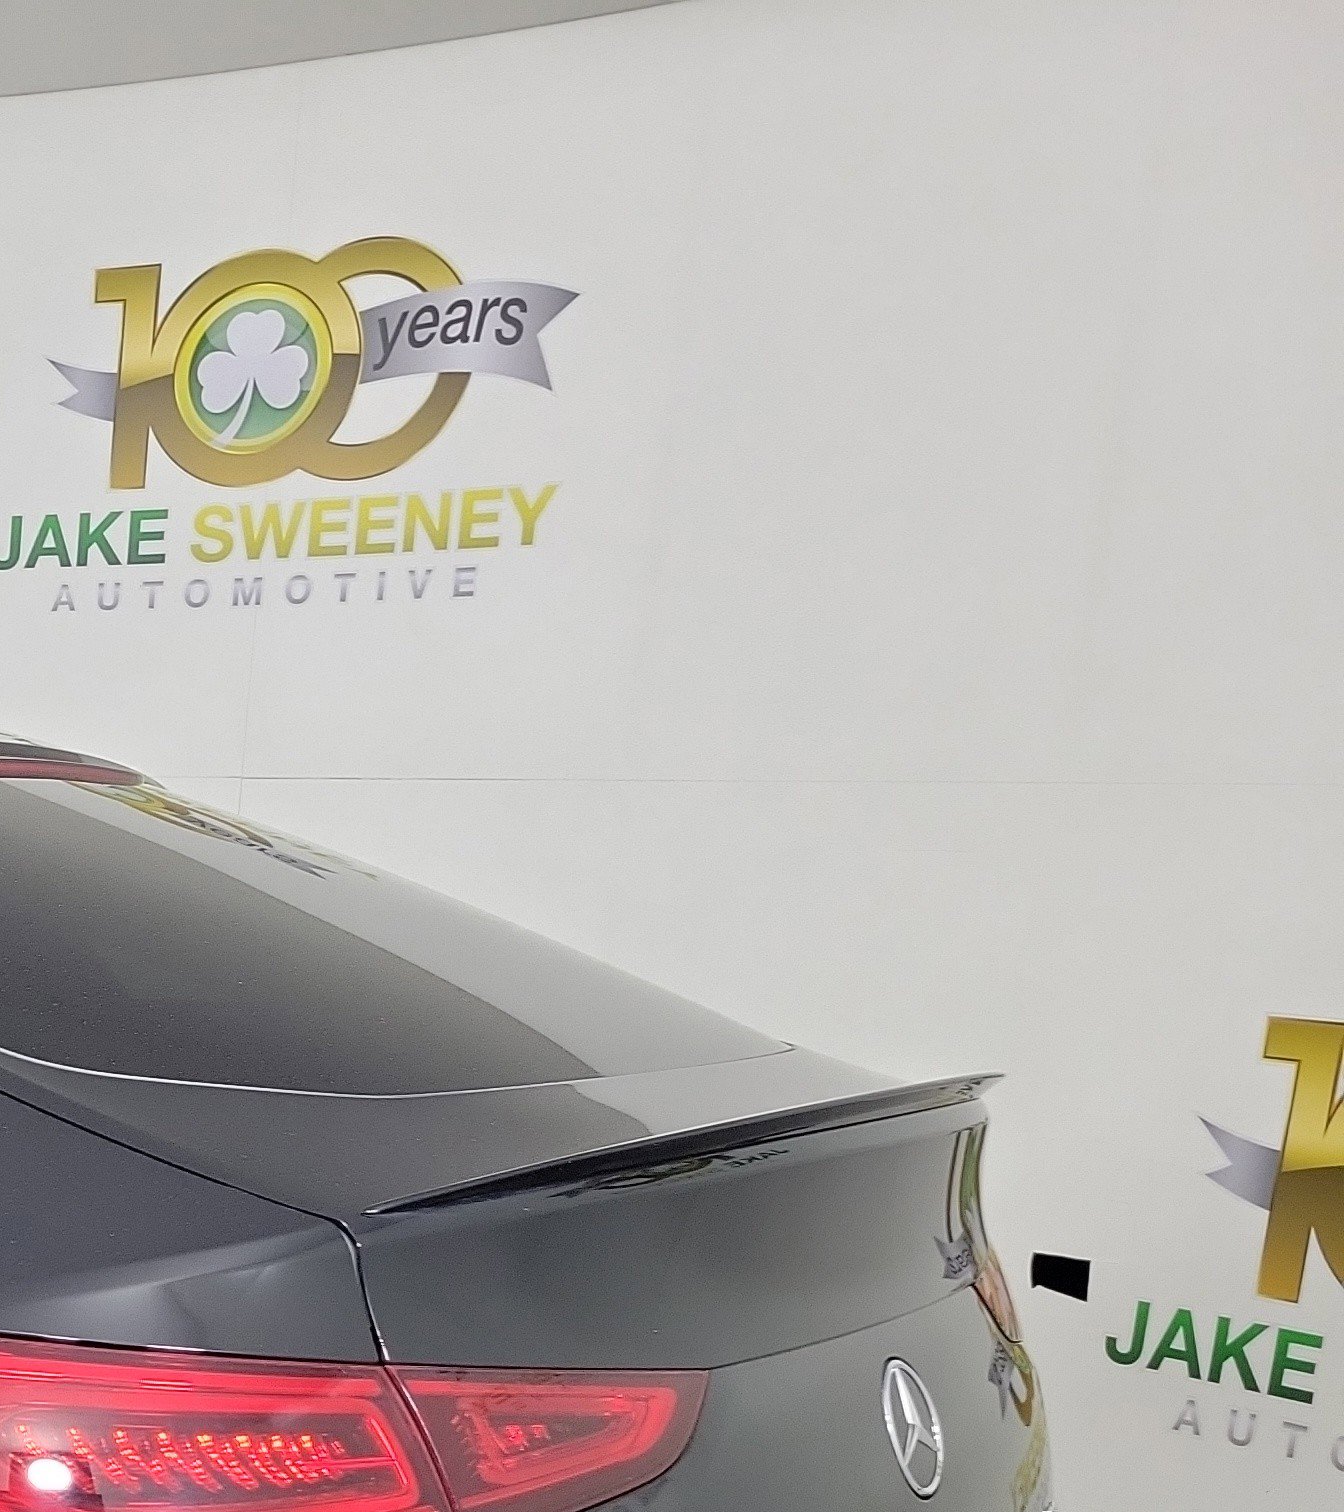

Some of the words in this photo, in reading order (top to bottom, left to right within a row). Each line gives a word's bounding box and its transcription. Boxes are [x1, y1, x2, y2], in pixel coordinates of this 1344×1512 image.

[94, 235, 472, 491] 100
[372, 296, 528, 370] years
[188, 483, 559, 565] SWEENEY
[50, 566, 478, 613] AUTOMOTIVE
[1104, 1300, 1325, 1405] JAKE
